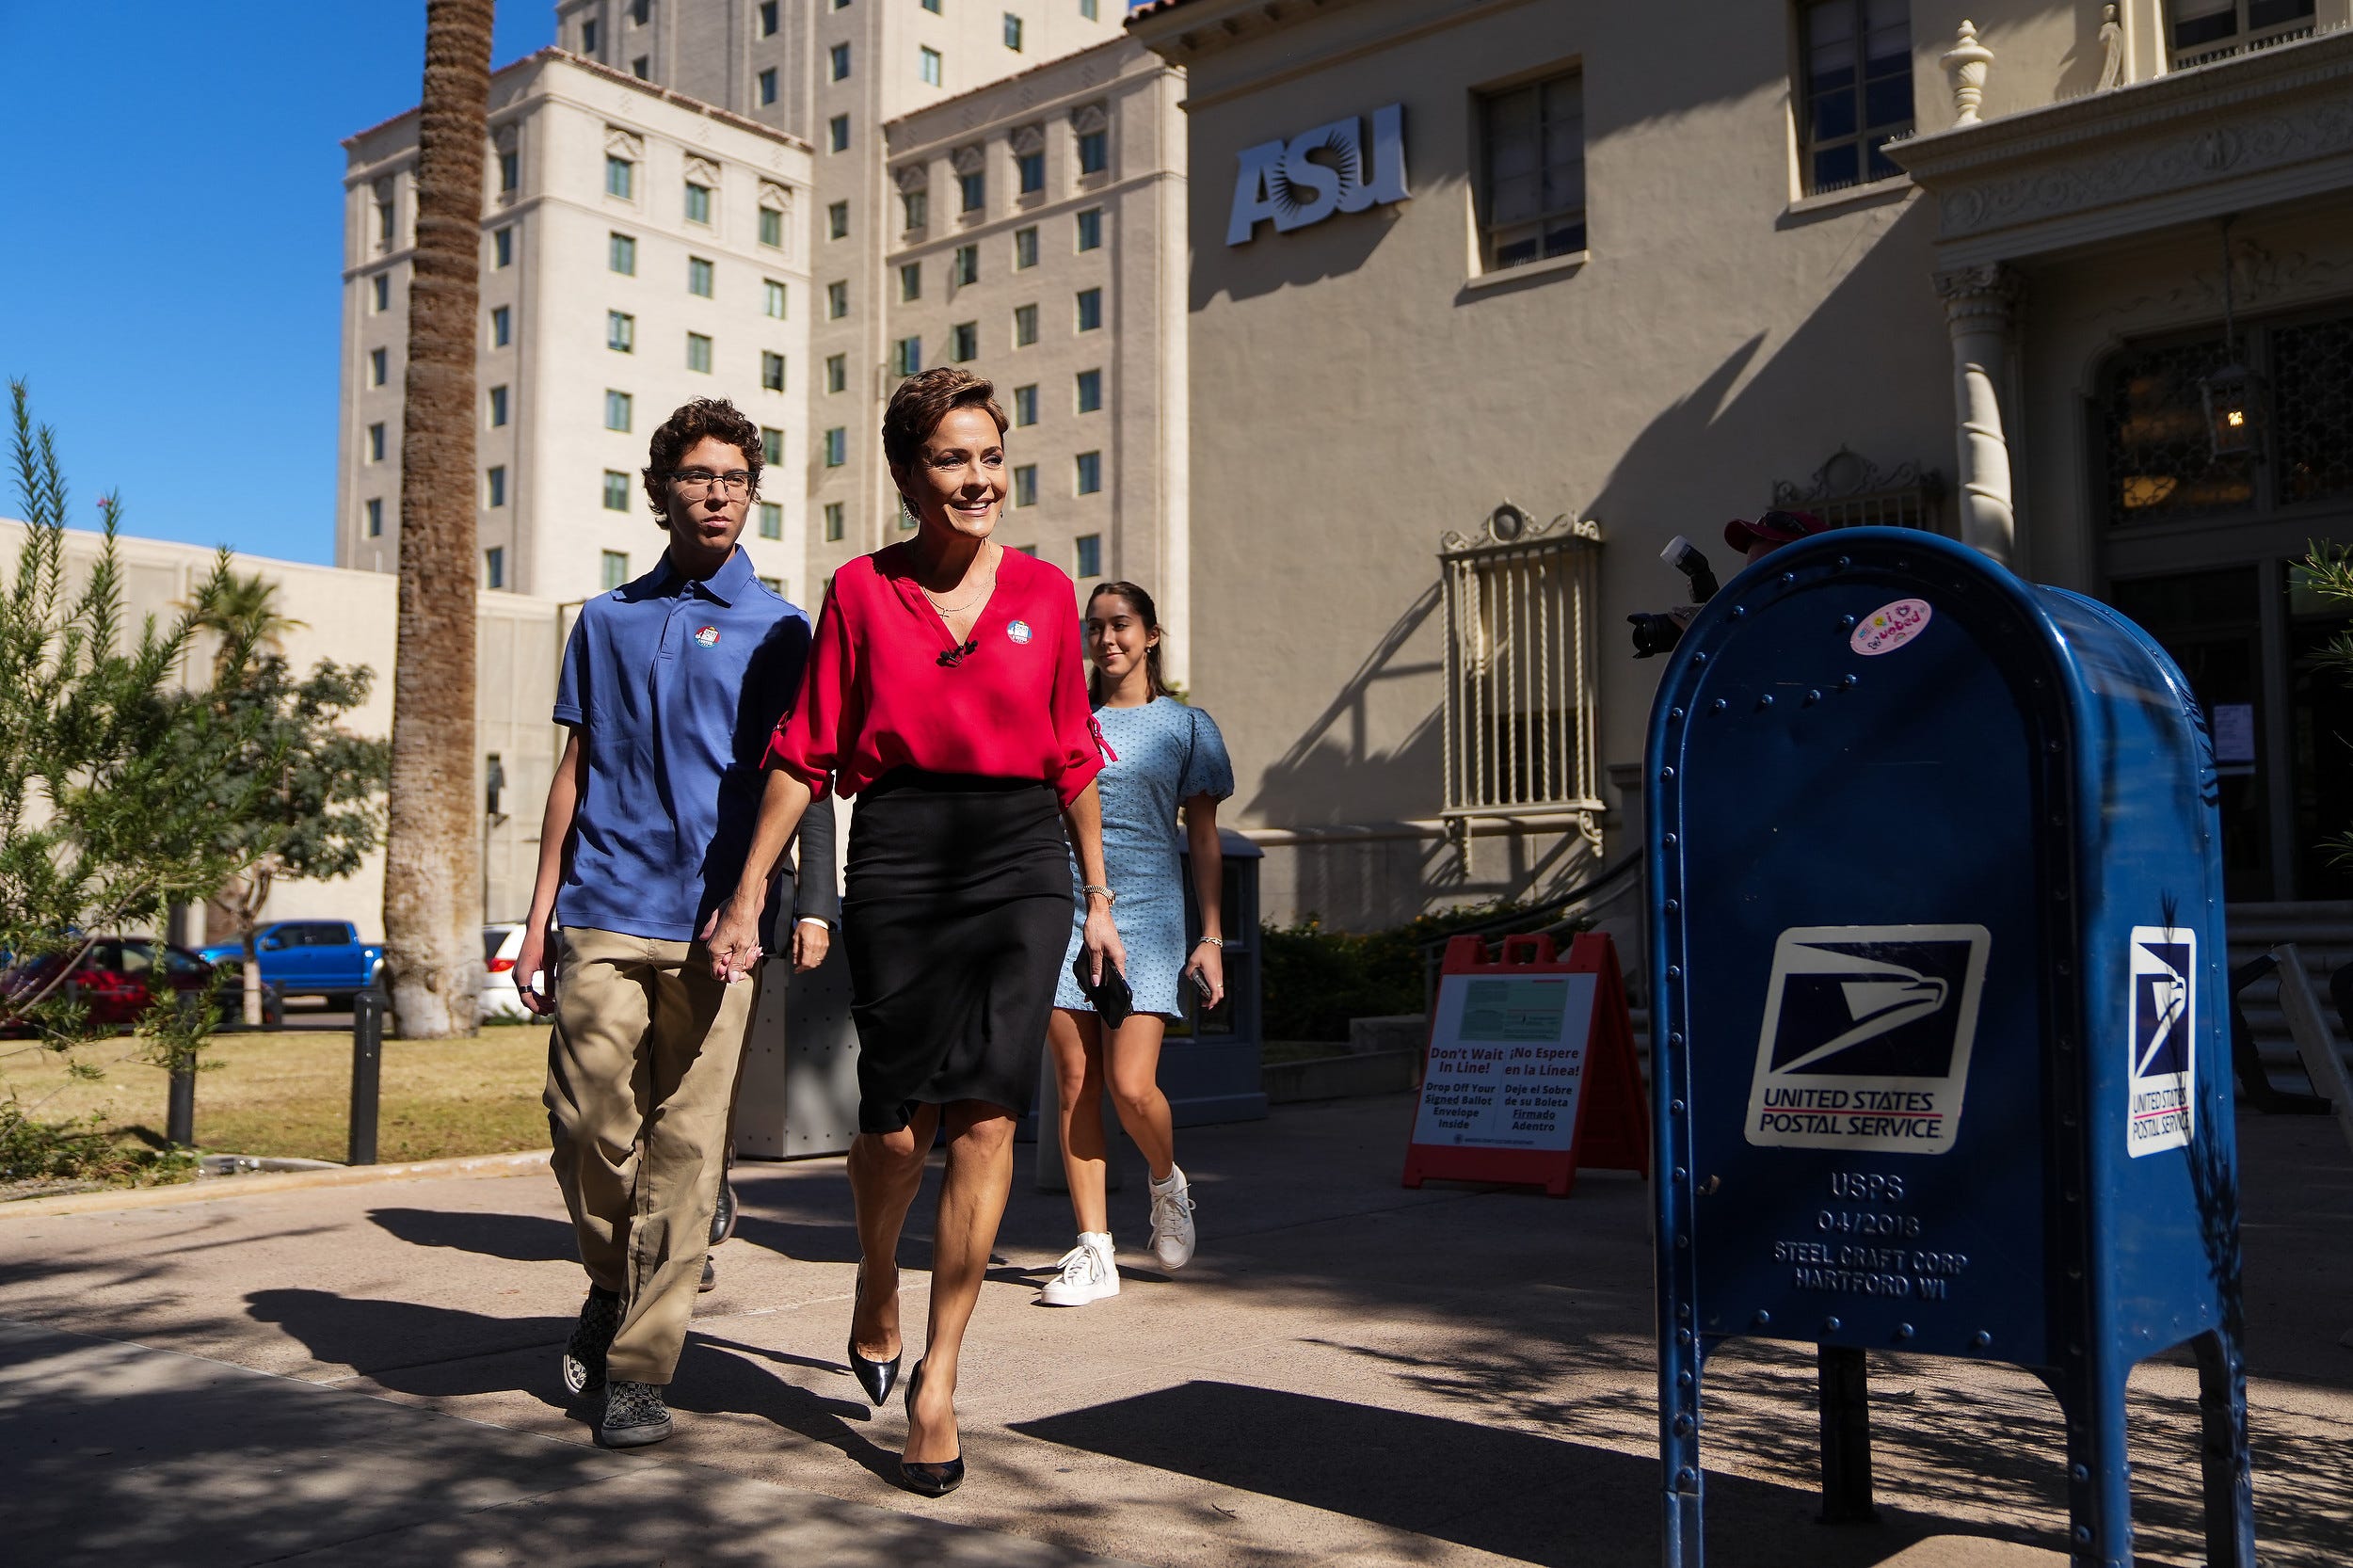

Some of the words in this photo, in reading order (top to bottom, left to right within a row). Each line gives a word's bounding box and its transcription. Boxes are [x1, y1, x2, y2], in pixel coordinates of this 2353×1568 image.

[1225, 103, 1412, 247] ASU
[1880, 611, 1920, 639] voted
[1431, 1048, 1467, 1060] Don't
[1472, 1048, 1504, 1060] Wait
[1511, 1048, 1532, 1060] ¡No
[1536, 1048, 1579, 1061] Espere
[1439, 1061, 1452, 1073] In
[1457, 1062, 1491, 1074] Line!
[1505, 1066, 1521, 1075] en
[1524, 1064, 1536, 1075] la
[1426, 1082, 1451, 1093] Drop
[1453, 1083, 1470, 1093] Off
[1472, 1083, 1497, 1093] Your
[1505, 1084, 1528, 1096] Deje
[1530, 1084, 1541, 1094] el
[1543, 1085, 1573, 1095] Sobre
[1425, 1095, 1460, 1106] Signed
[1462, 1096, 1493, 1106] Ballot
[1505, 1096, 1517, 1106] de
[1535, 1097, 1569, 1108] Boleta
[1764, 1088, 1849, 1109] UNITED
[1852, 1091, 1935, 1112] STATES
[2133, 1092, 2162, 1113] UNITED
[2163, 1087, 2186, 1108] STATES
[1433, 1107, 1480, 1119] Envelope
[1513, 1109, 1556, 1120] Firmado
[1439, 1119, 1470, 1129] Inside
[1513, 1121, 1556, 1131] Adentro
[1759, 1113, 1842, 1135] POSTAL
[1847, 1116, 1943, 1139] SERVICE
[2133, 1119, 2161, 1142] POSTAL
[2162, 1112, 2190, 1135] SERVICE
[1831, 1171, 1906, 1202] USPS
[1773, 1240, 1835, 1265] STEEL
[1839, 1244, 1907, 1272] CRAFT
[1912, 1250, 1969, 1276] CORP
[1795, 1266, 1911, 1296] HARTFORD
[1918, 1276, 1947, 1301] WI
